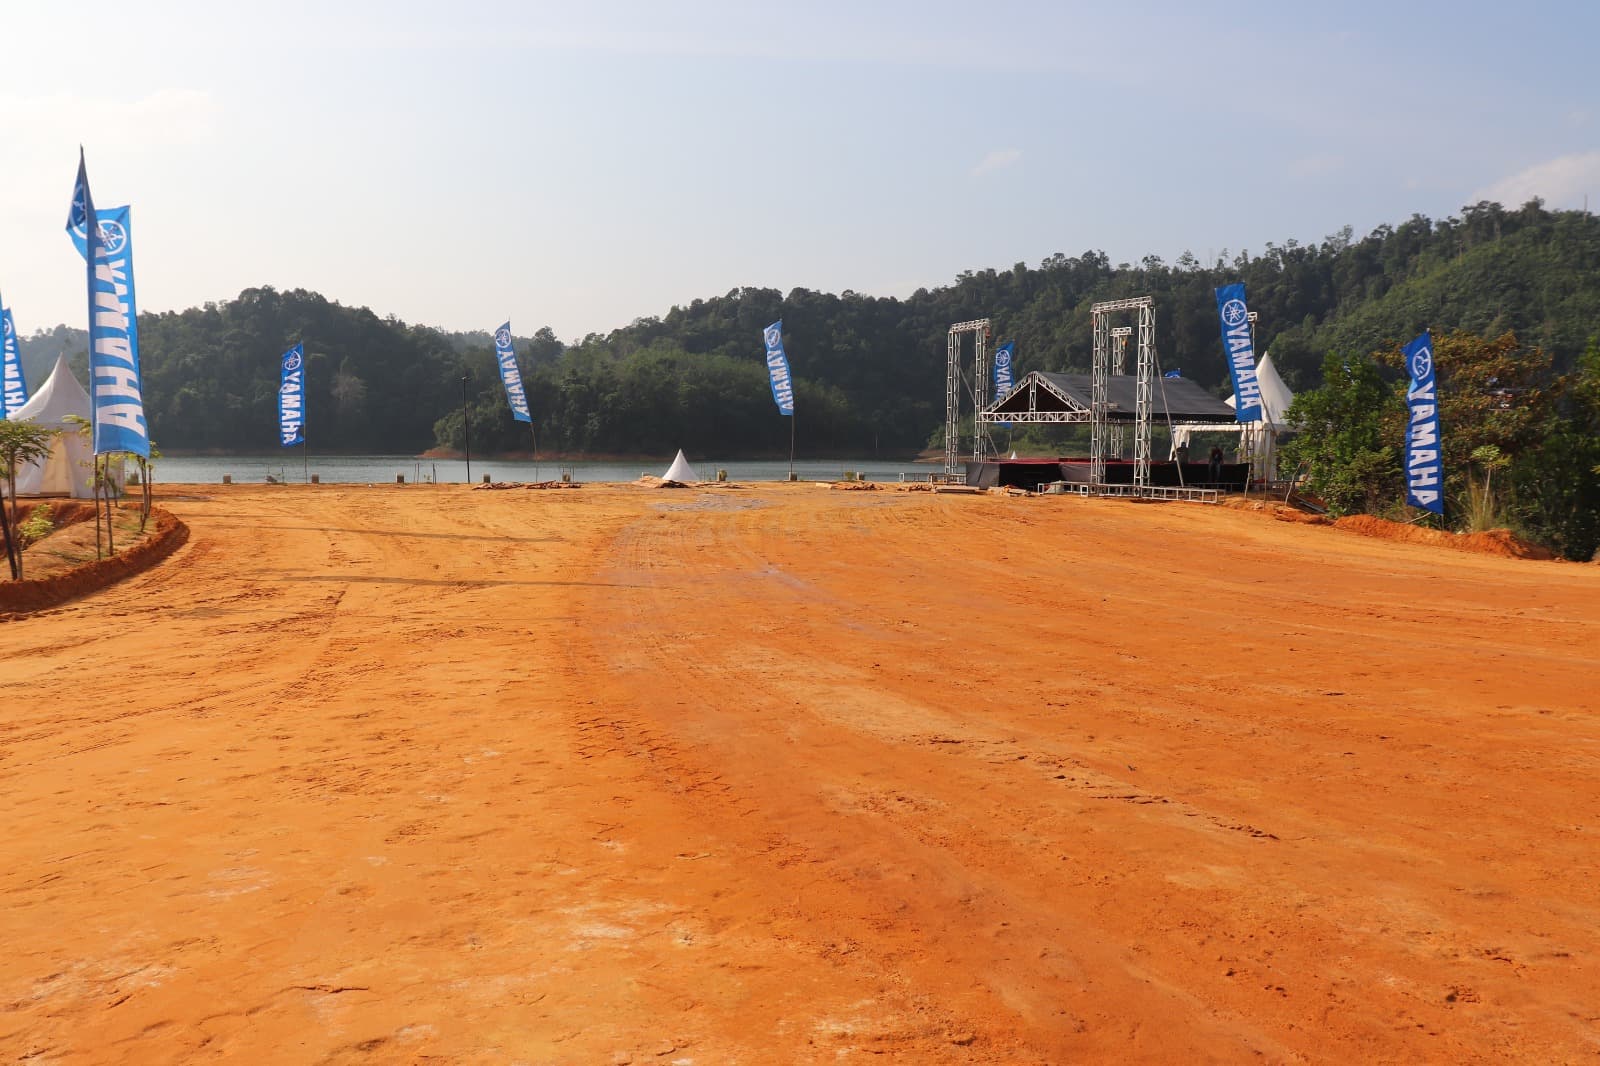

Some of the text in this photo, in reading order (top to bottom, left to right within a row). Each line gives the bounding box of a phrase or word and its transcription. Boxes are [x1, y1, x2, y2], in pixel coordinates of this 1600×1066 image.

[996, 367, 1012, 398] YAM
[1226, 323, 1261, 410] YAMAHA
[279, 371, 301, 444] YAMAHA
[1408, 381, 1438, 505] YAMAHA
